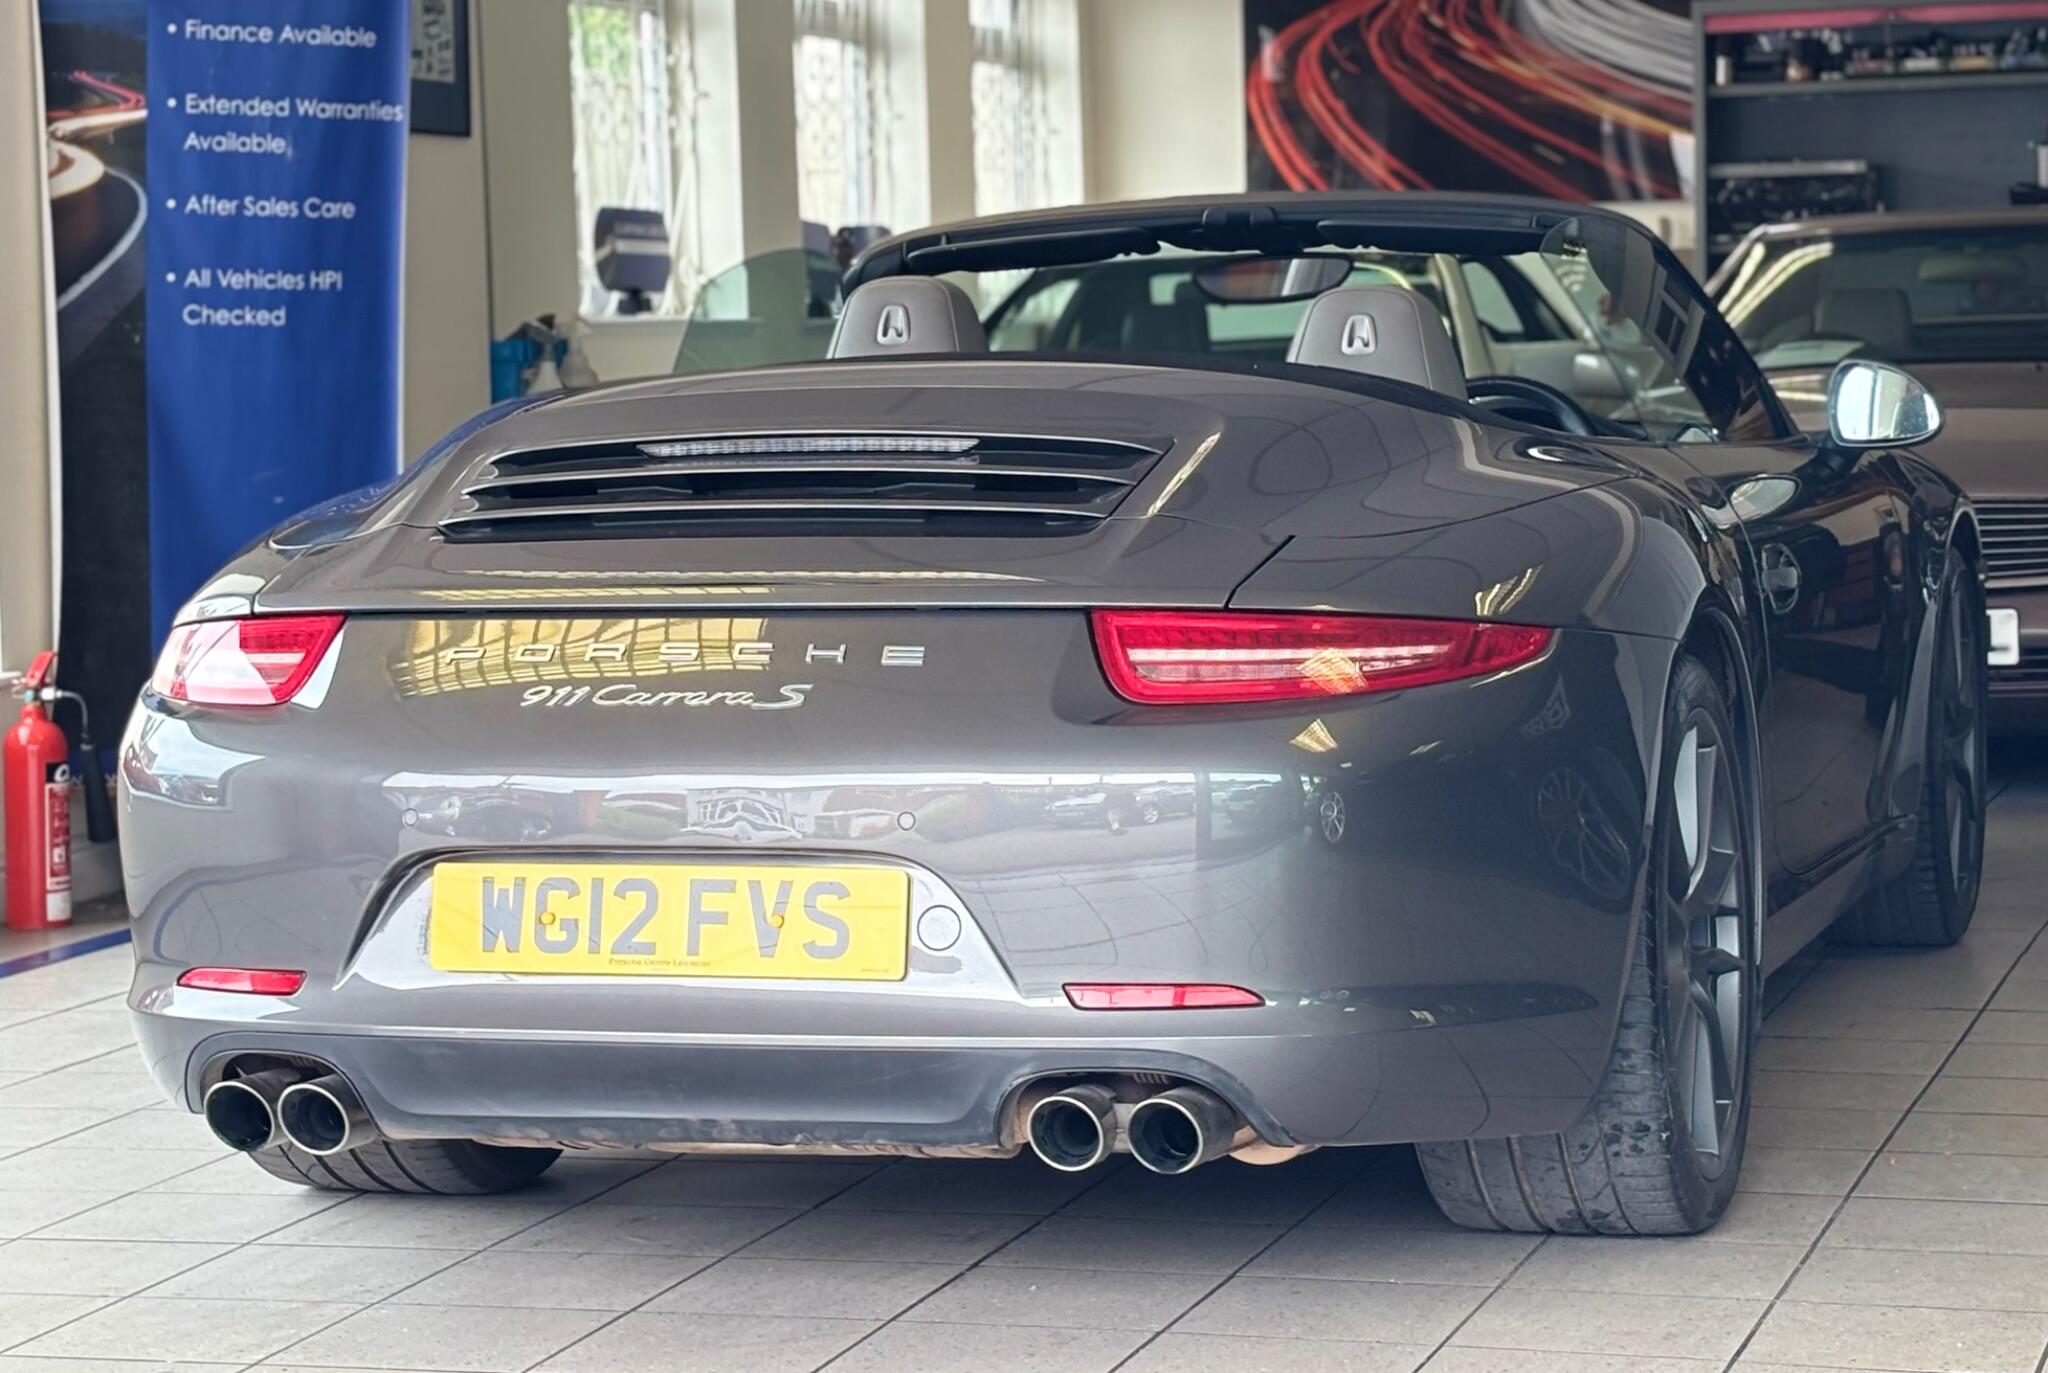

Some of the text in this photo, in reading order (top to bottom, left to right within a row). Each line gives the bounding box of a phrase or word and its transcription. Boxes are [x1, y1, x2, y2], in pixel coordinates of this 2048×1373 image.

[185, 19, 377, 47] Finance Available
[185, 93, 404, 122] Extended Warranties
[184, 194, 356, 219] After Sales Care
[183, 268, 343, 291] All Vehicles HPI
[182, 304, 286, 326] Checked
[445, 642, 927, 667] PORSCHE
[520, 683, 814, 709] 911 Carrera S
[482, 876, 851, 960] WG12 FVS
